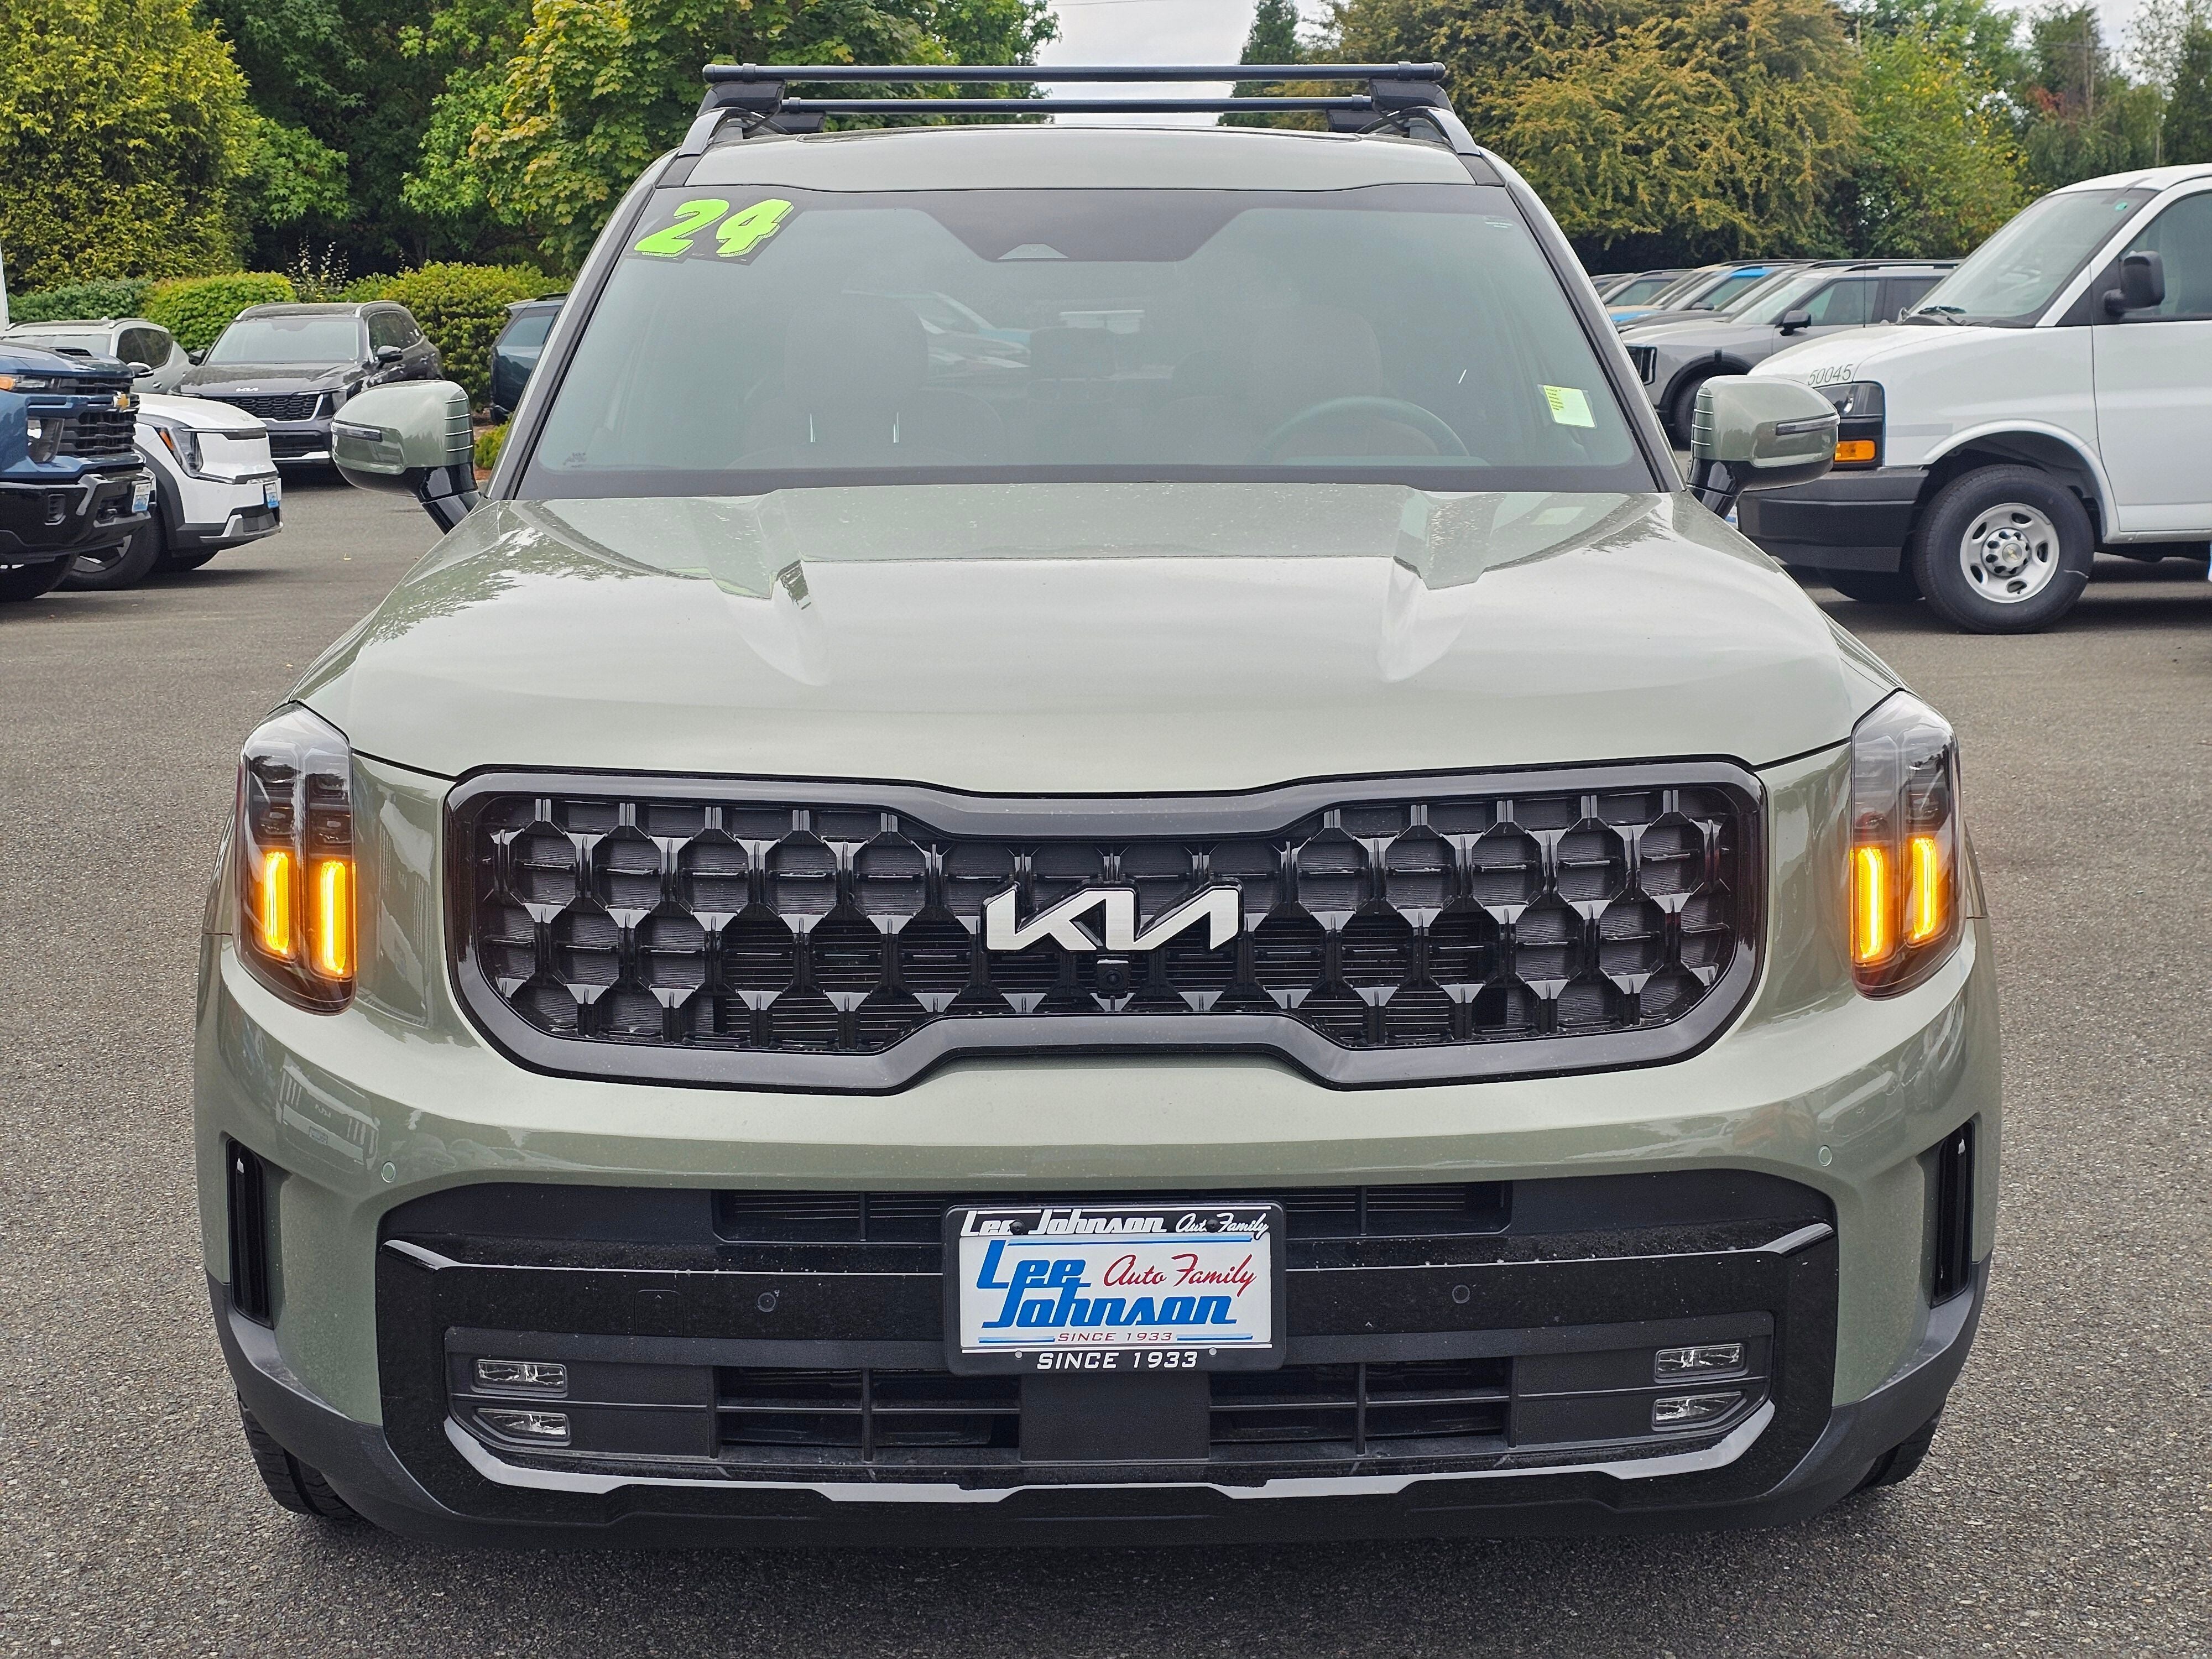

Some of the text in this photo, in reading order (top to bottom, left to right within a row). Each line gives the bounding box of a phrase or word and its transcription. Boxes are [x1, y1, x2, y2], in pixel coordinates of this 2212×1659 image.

[634, 199, 795, 257] 24
[1808, 364, 1853, 385] 50045
[986, 889, 1239, 951] KIA
[1027, 1209, 1167, 1235] Johnson
[1175, 1213, 1209, 1233] Aut
[1216, 1213, 1269, 1239] Family
[976, 1239, 1092, 1289] Lee
[1103, 1253, 1258, 1297] Auto Family
[982, 1277, 1238, 1328] Johnson
[1057, 1332, 1173, 1342] SINCE 1933
[1036, 1351, 1198, 1370] SINCE 1933
